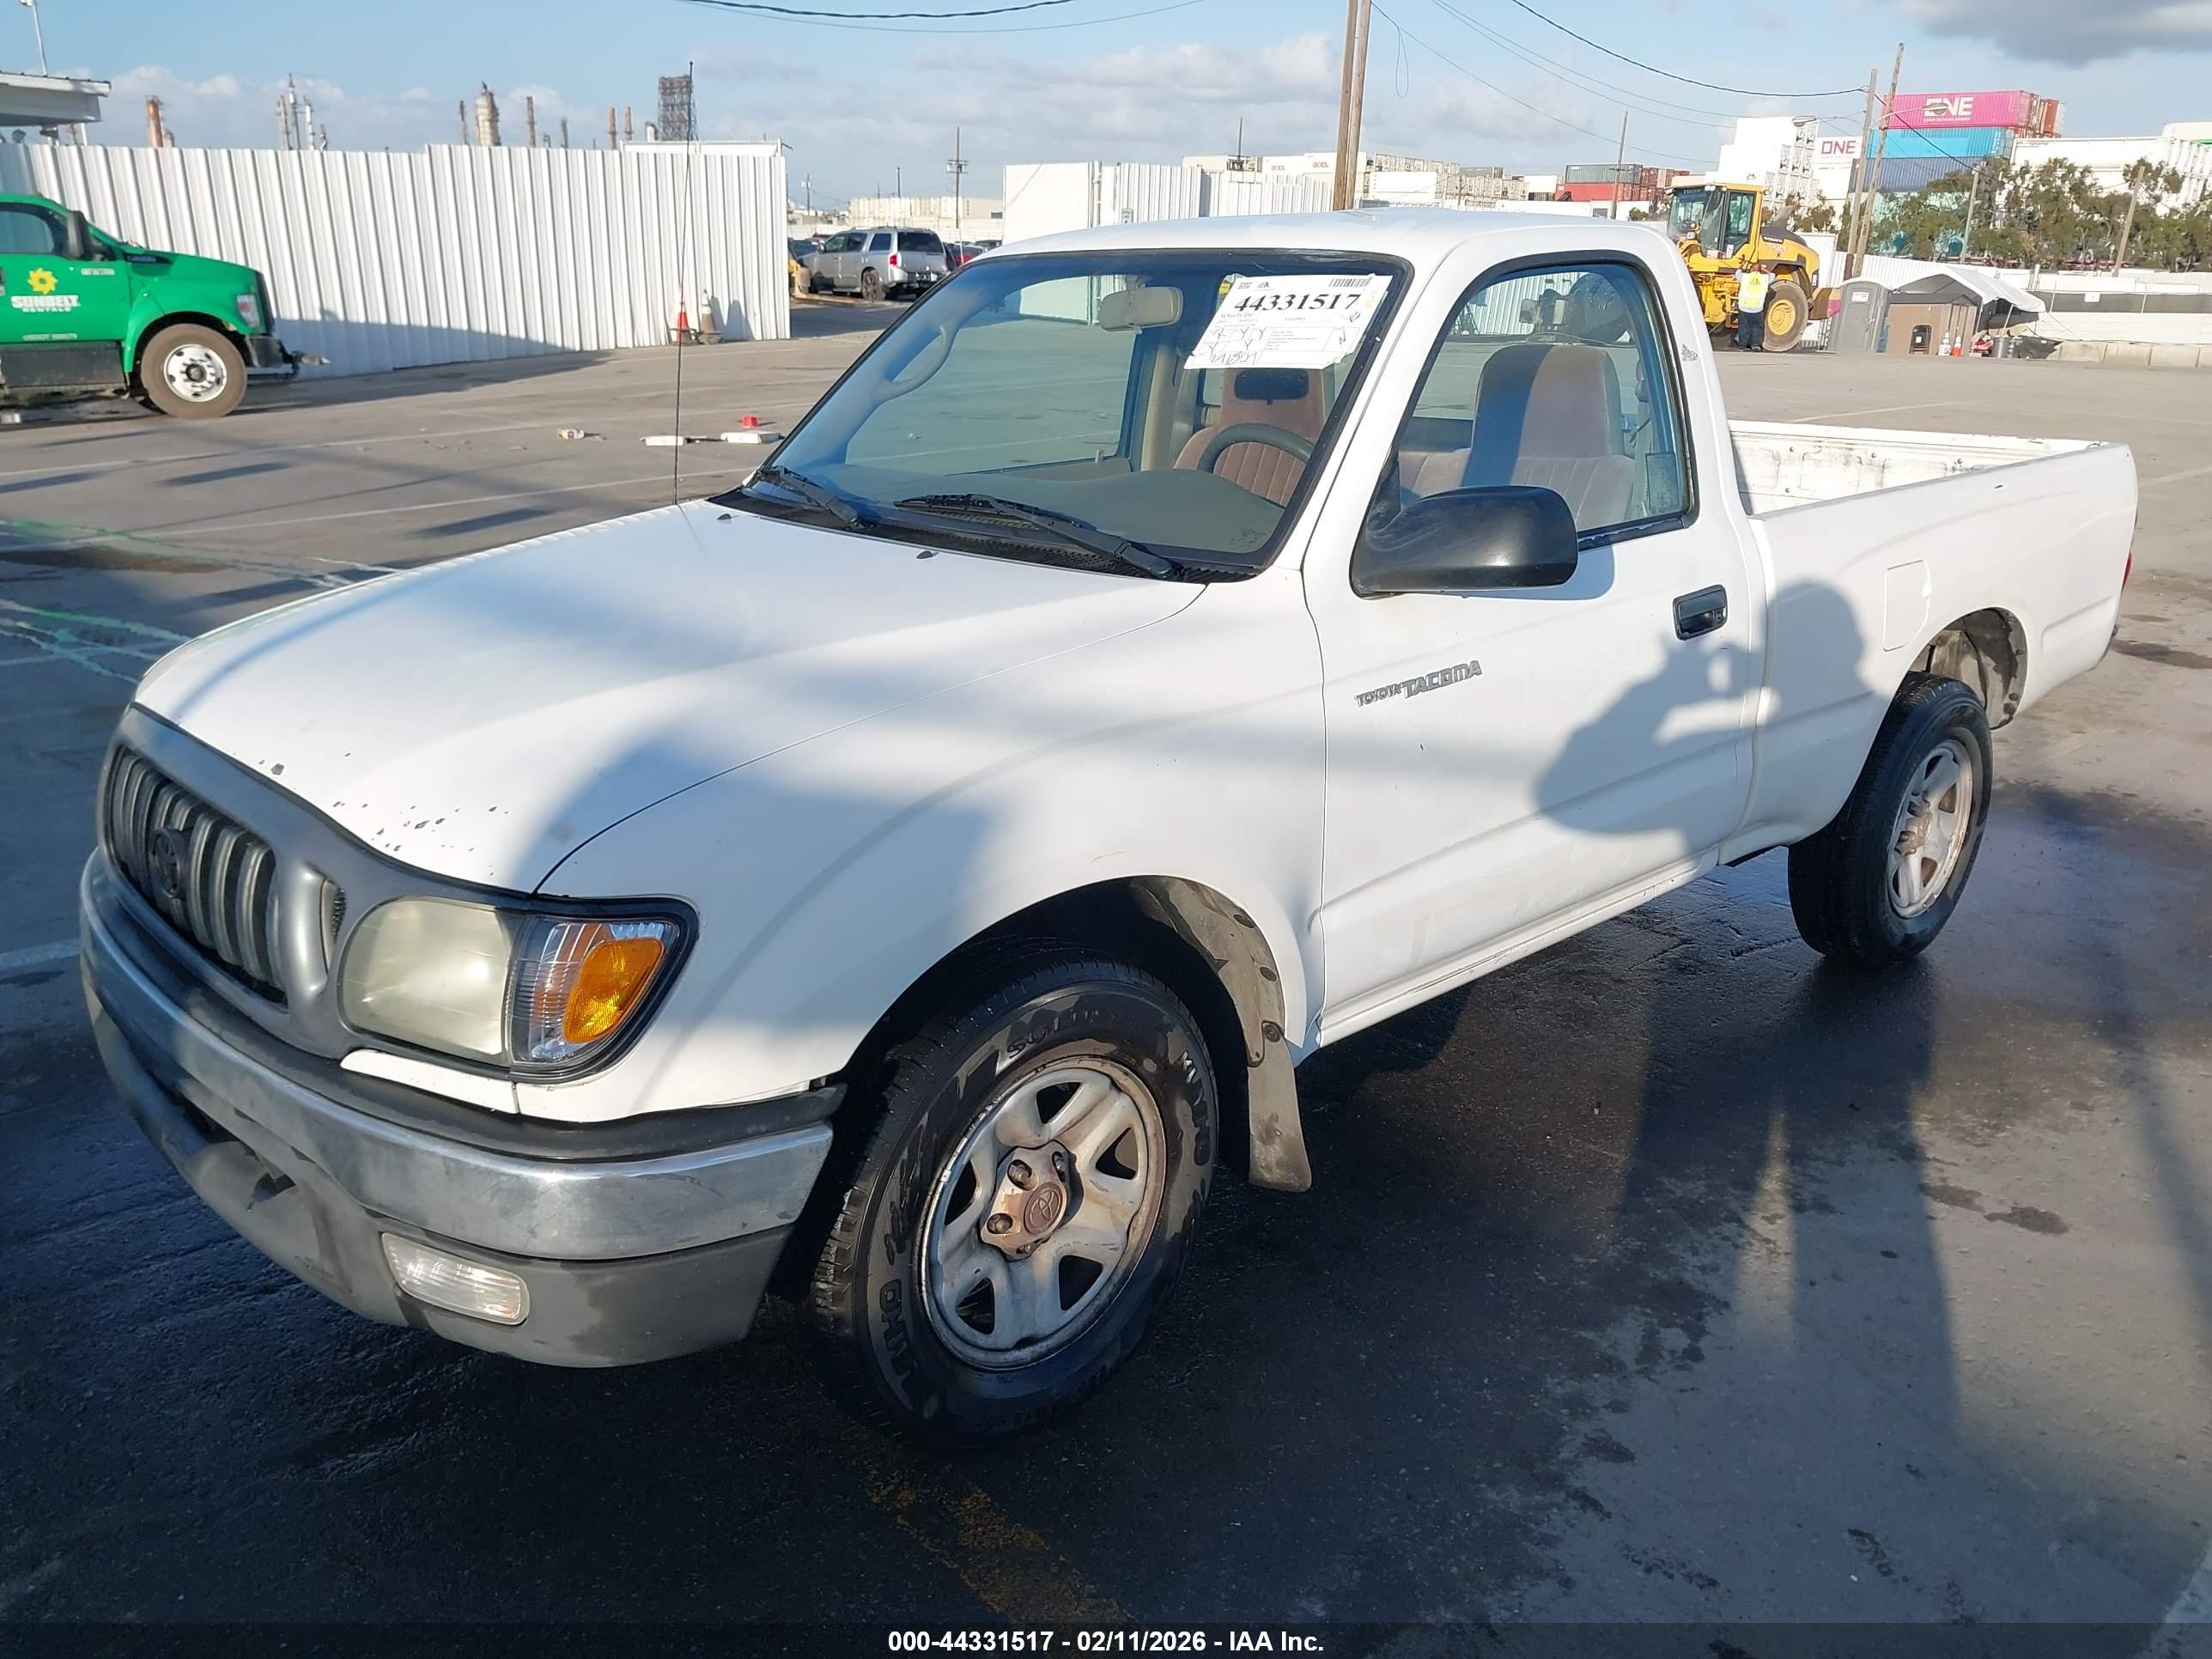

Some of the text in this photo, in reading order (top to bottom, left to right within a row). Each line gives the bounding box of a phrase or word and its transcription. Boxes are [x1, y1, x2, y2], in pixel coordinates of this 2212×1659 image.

[1820, 140, 1856, 155] ONE
[1234, 293, 1362, 312] 44331517
[1354, 659, 1483, 708] TOYOTA TACOMA
